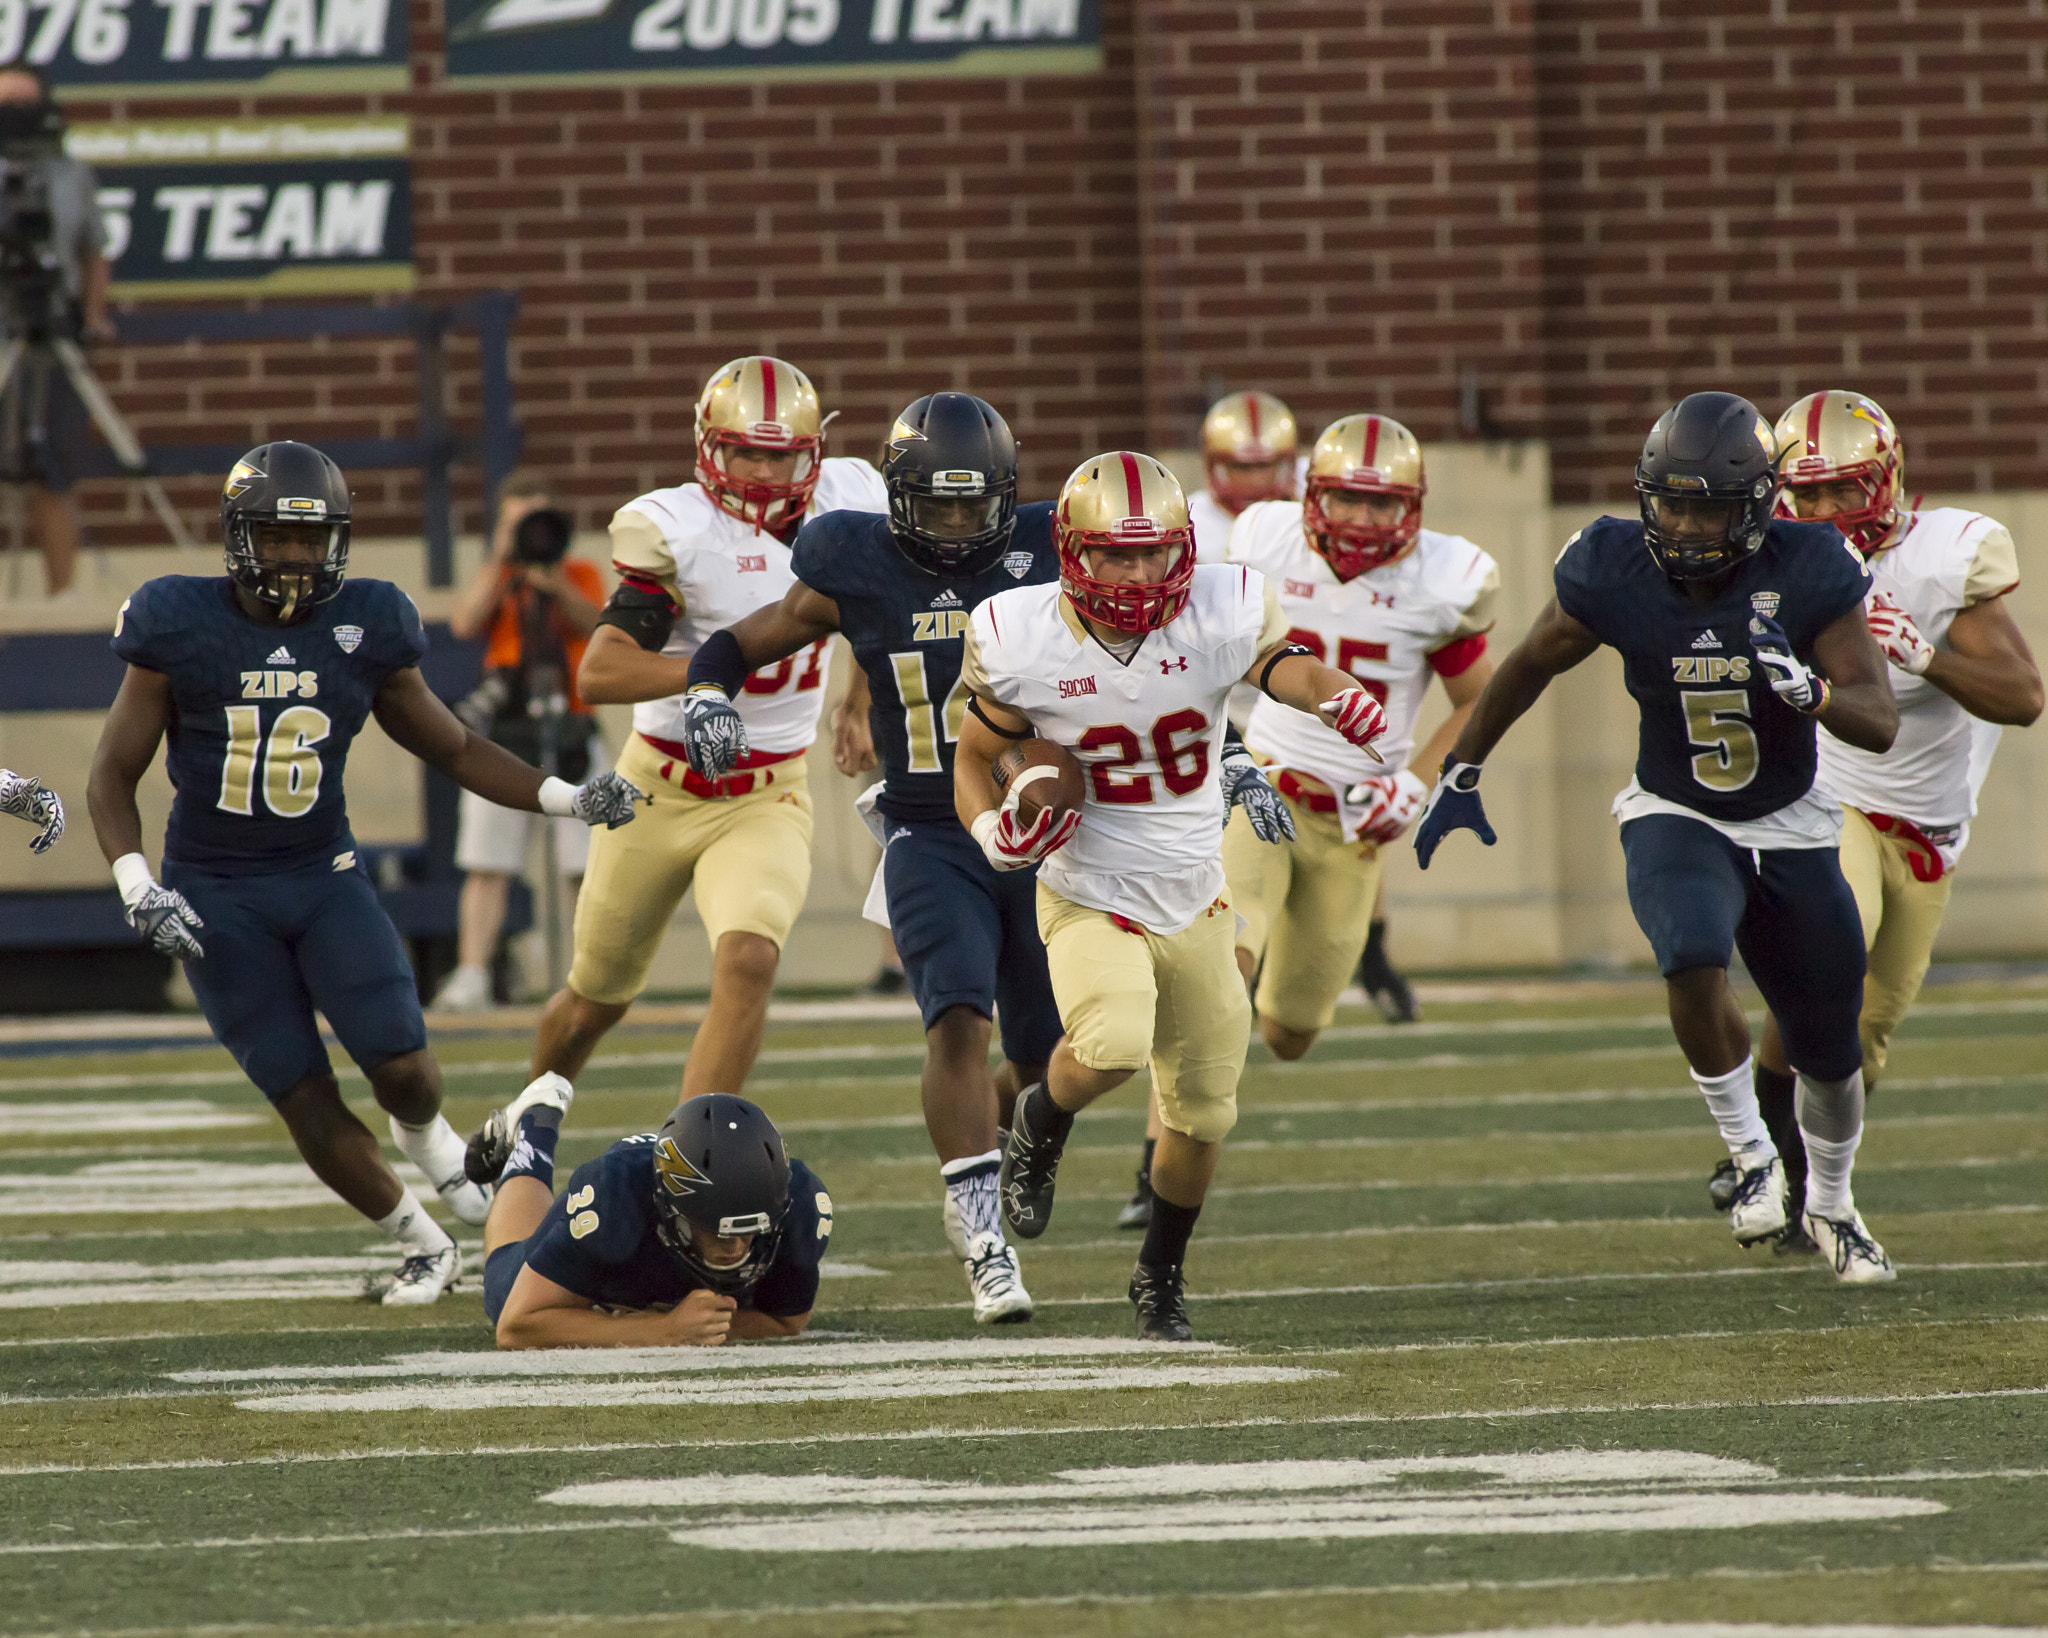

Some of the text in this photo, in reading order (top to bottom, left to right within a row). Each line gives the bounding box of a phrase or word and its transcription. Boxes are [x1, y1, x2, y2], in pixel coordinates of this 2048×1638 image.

[152, 0, 390, 61] TEAM
[630, 0, 841, 50] 2005
[153, 180, 393, 261] TEAM
[930, 600, 963, 608] adidas
[912, 610, 970, 641] ZIP
[1691, 641, 1723, 649] adidas
[240, 670, 318, 699] ZIPS
[1058, 675, 1098, 699] SOCON
[1672, 656, 1751, 682] ZIPS
[1076, 706, 1211, 805] 26
[1680, 689, 1760, 792] 5
[216, 705, 331, 818] 16
